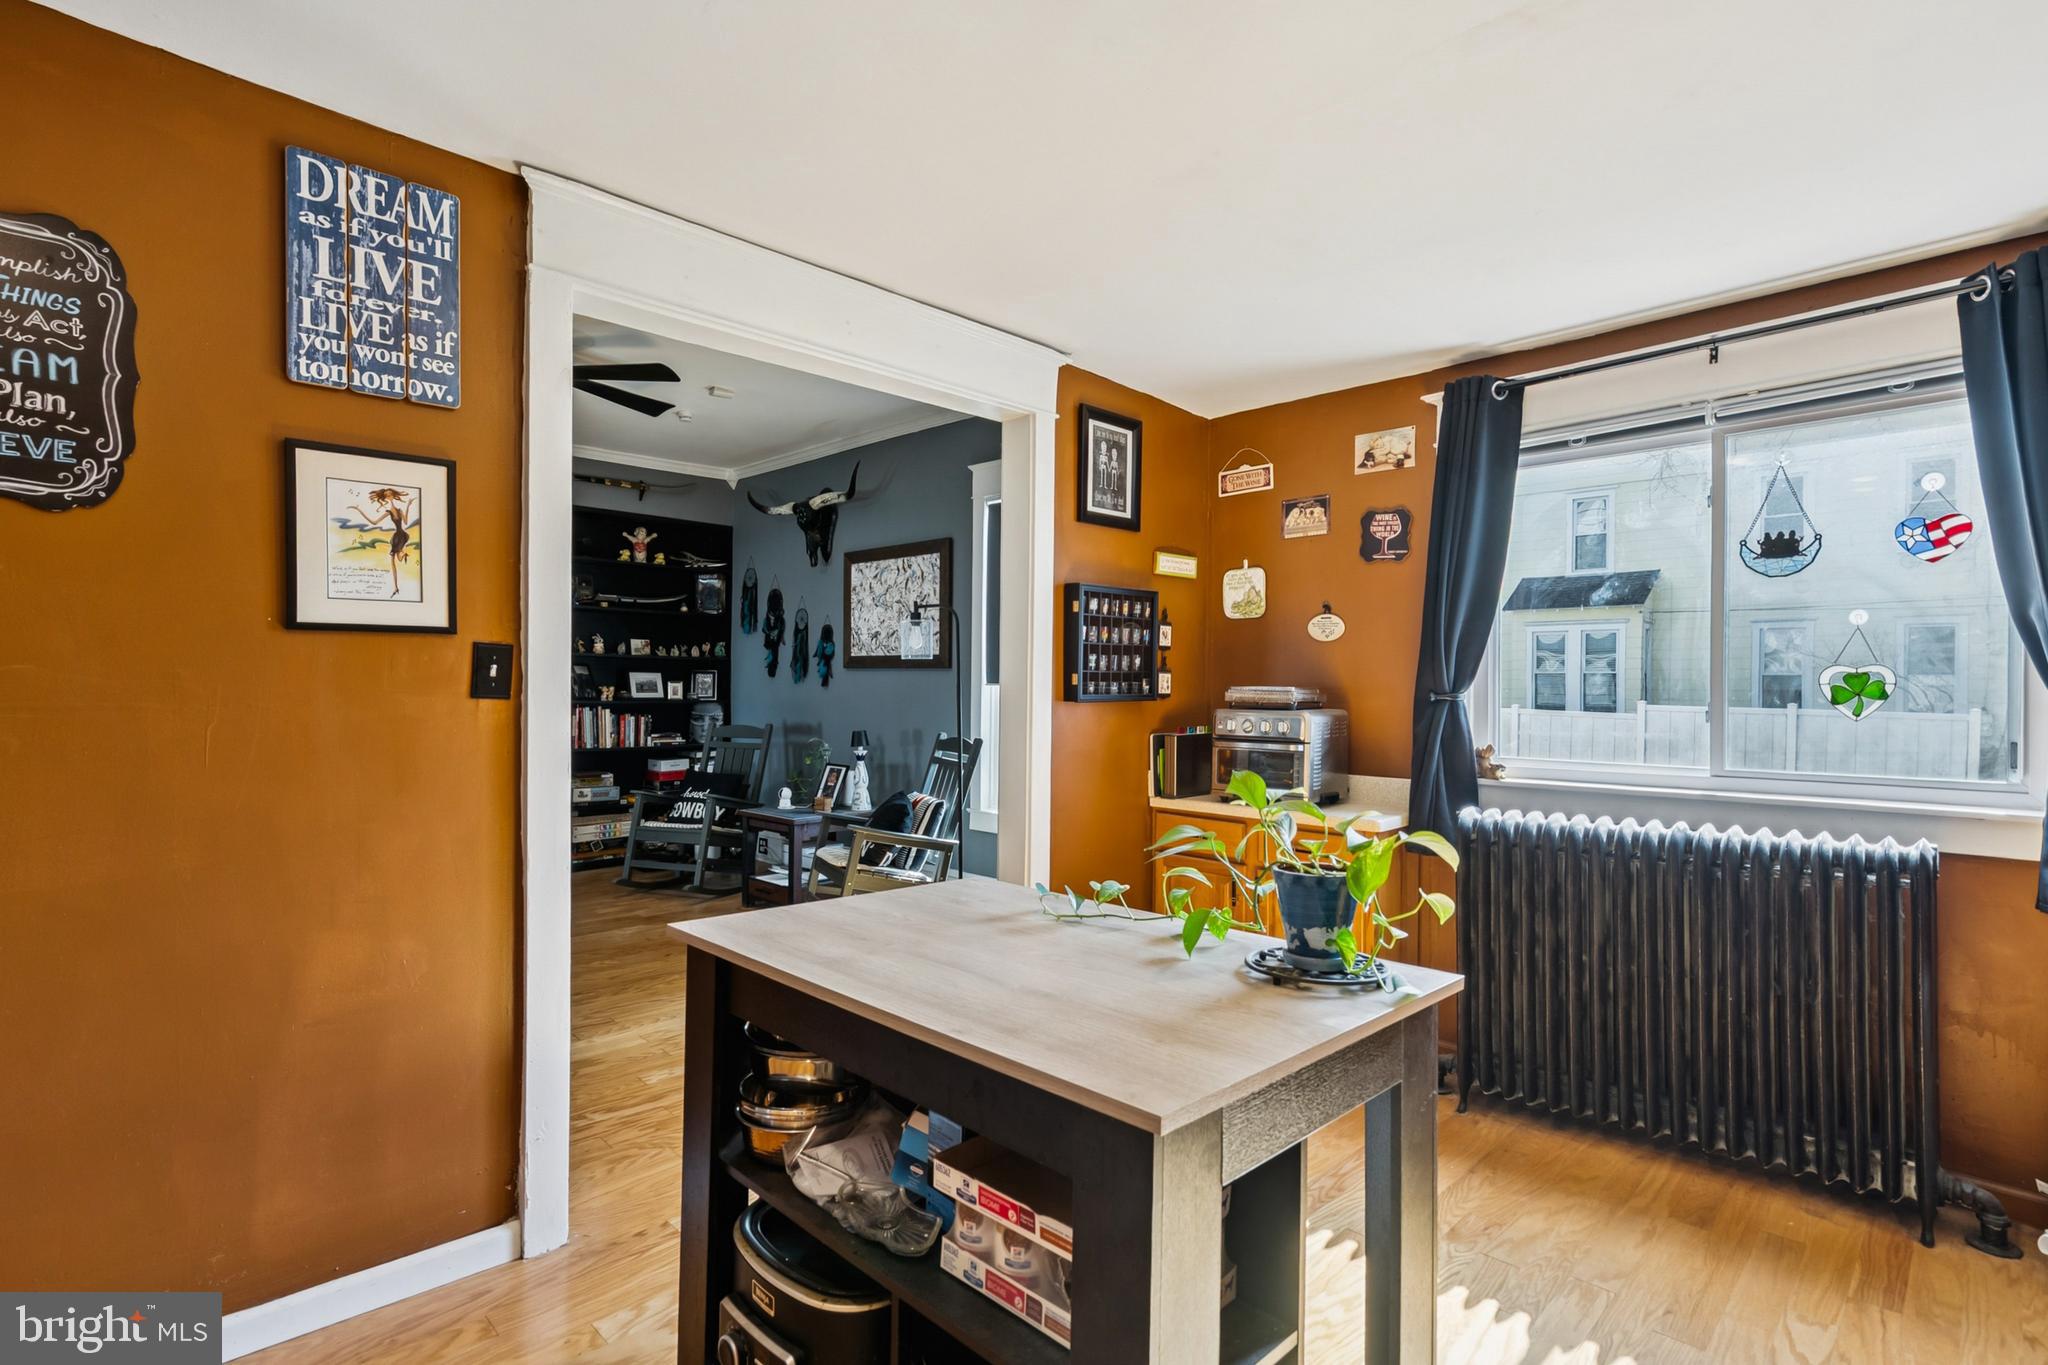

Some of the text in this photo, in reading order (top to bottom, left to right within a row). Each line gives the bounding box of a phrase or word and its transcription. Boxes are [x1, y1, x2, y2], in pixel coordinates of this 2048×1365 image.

[296, 154, 453, 239] DREAM
[299, 211, 453, 262] as if you'll
[312, 235, 442, 306] LIVE
[312, 280, 443, 324] forever.
[0, 326, 37, 342] lso
[23, 310, 87, 340] Act,
[298, 296, 457, 357] LIVE as if
[0, 348, 79, 385] AM
[298, 332, 348, 354] you
[422, 356, 455, 375] see
[297, 357, 454, 402] tomorrow.
[0, 409, 46, 427] lso
[669, 801, 726, 821] OWBY
